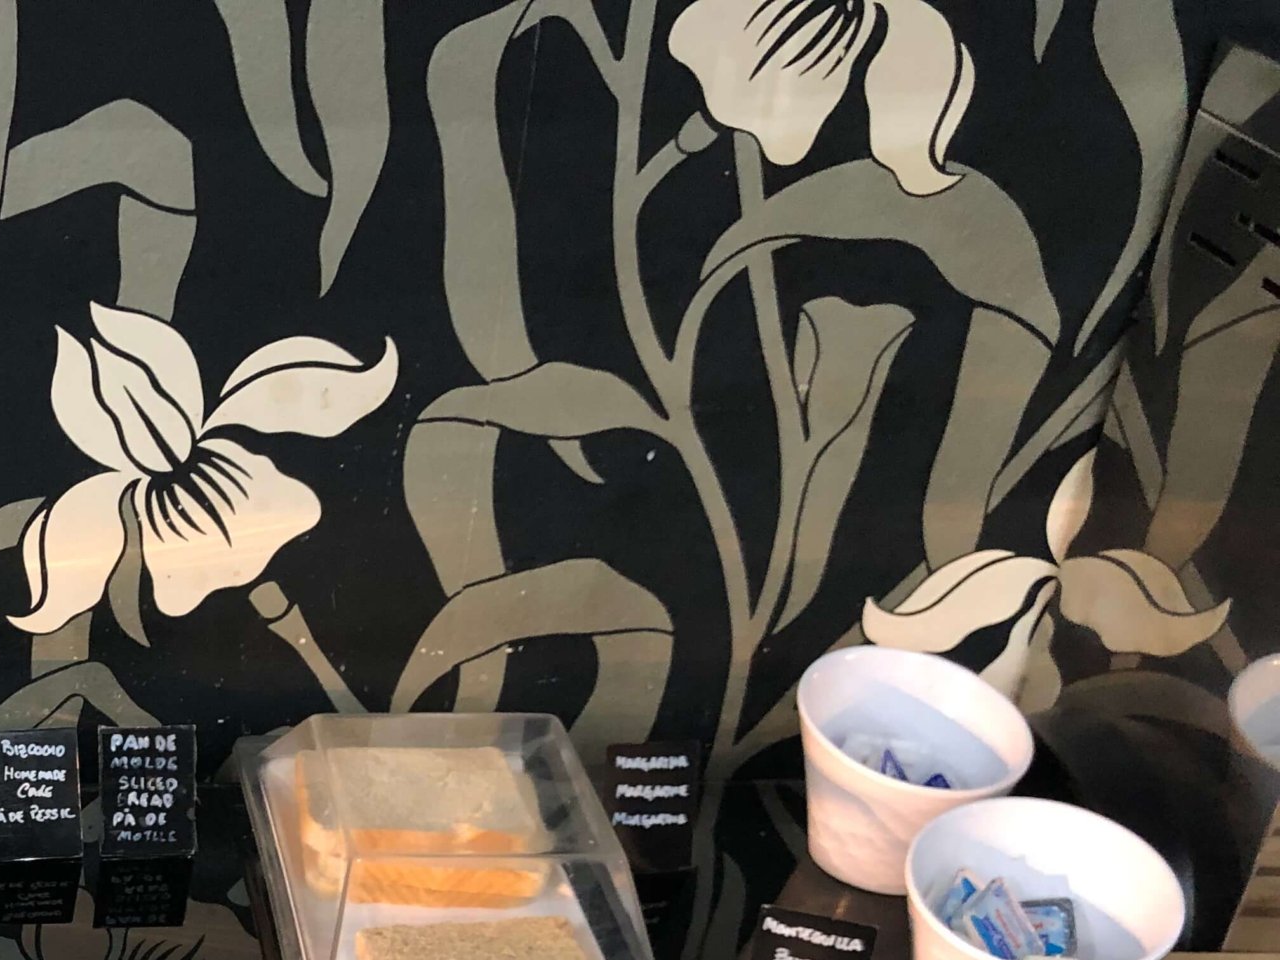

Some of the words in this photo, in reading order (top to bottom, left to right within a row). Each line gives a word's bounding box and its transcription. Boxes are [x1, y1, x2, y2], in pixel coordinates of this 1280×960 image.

[110, 733, 150, 752] PAN
[154, 733, 176, 752] DE
[110, 756, 178, 770] MOLDE
[16, 782, 54, 798] CAKE
[118, 775, 178, 792] SLICED
[8, 811, 25, 823] DE
